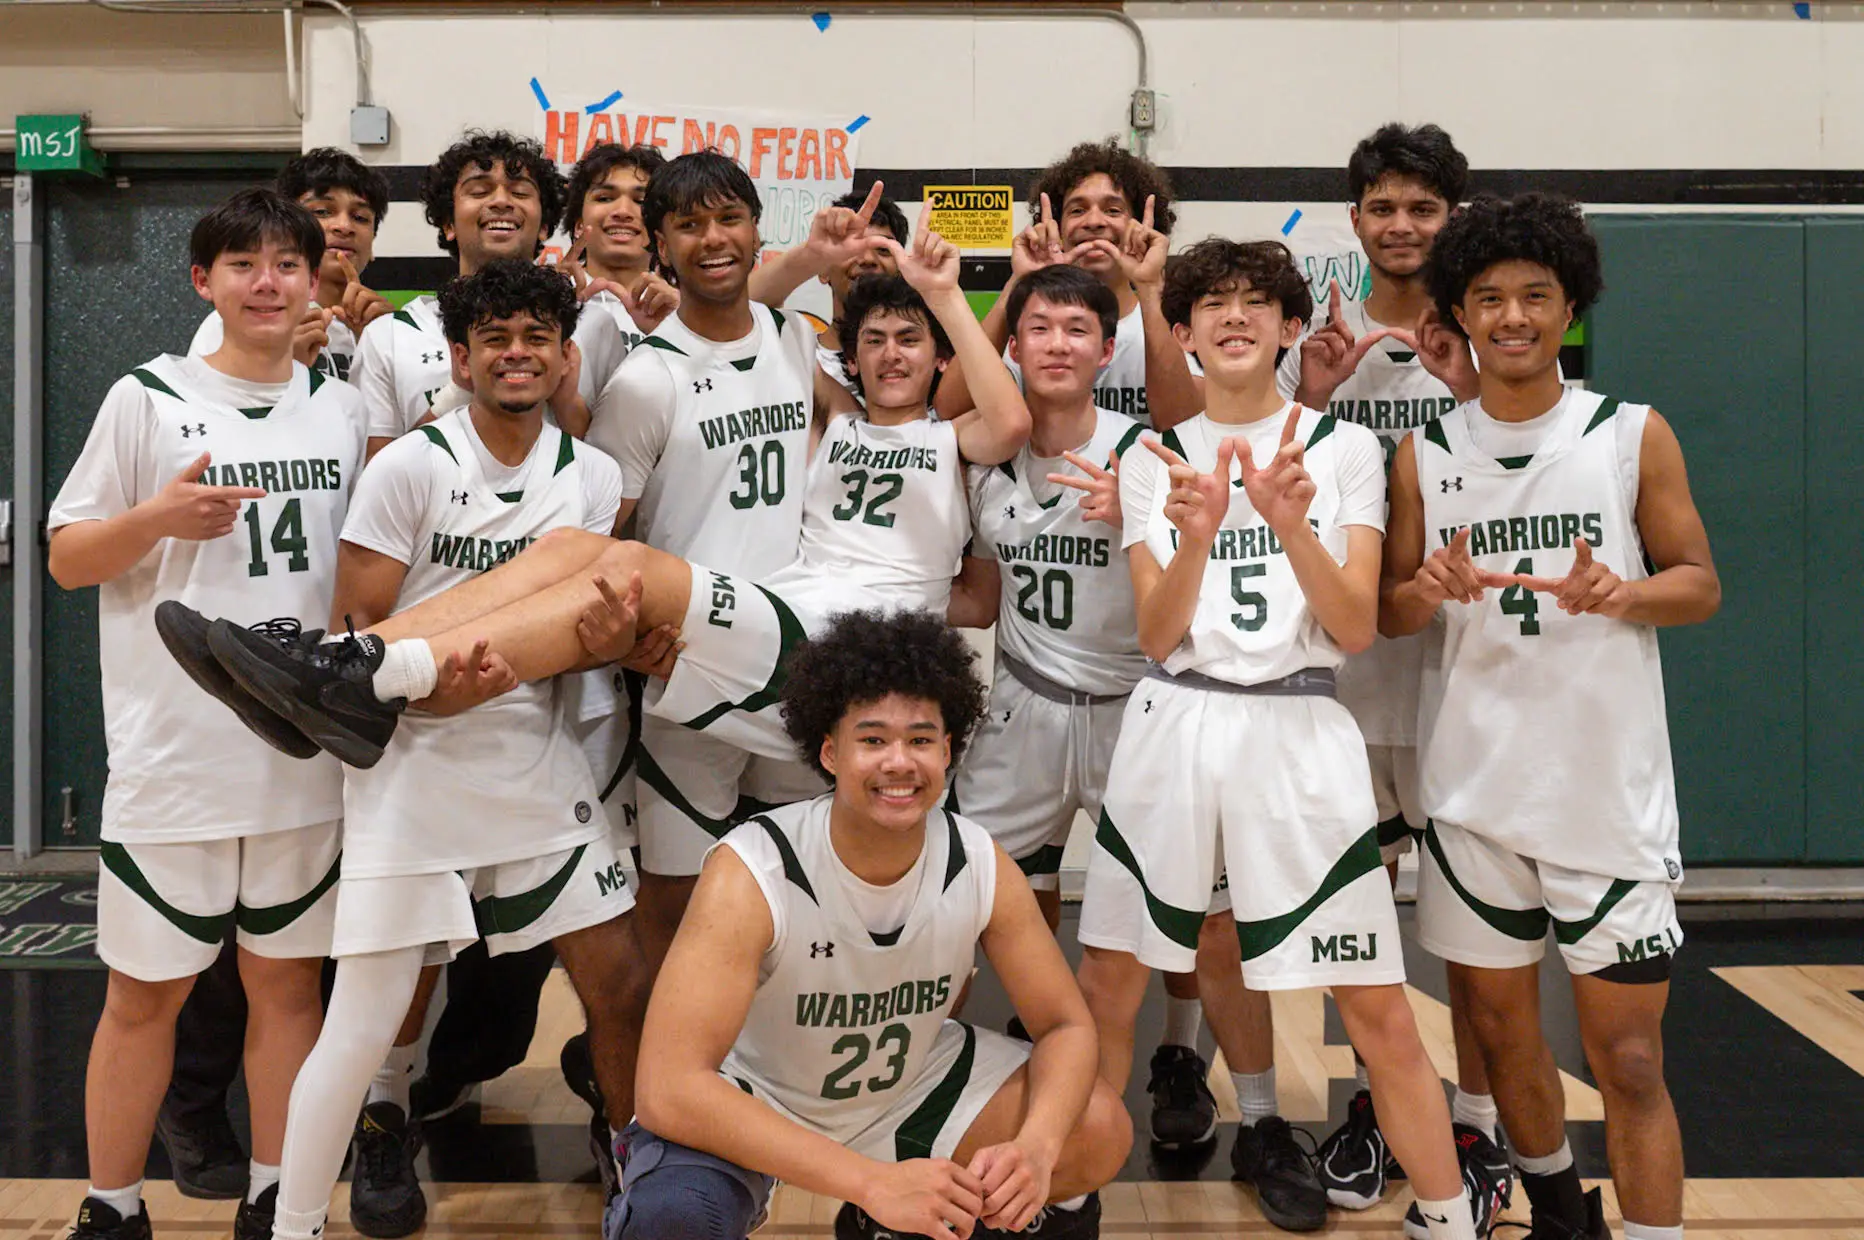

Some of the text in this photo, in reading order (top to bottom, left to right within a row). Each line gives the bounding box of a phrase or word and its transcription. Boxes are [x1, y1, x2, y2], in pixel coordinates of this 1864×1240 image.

[544, 110, 852, 180] HAVE NO FEAR
[932, 193, 1007, 209] CAUTION
[698, 401, 807, 450] WARRIORS
[828, 440, 937, 472] WARRIORS
[729, 439, 786, 510] 30
[832, 469, 904, 529] 32
[244, 498, 309, 577] 14
[708, 570, 736, 630] MSJ
[1012, 564, 1074, 631] 20
[1230, 563, 1268, 632] 5
[1499, 557, 1540, 636] 4
[1311, 933, 1377, 963] MSJ
[796, 974, 951, 1028] WARRIORS
[820, 1023, 912, 1100] 23
